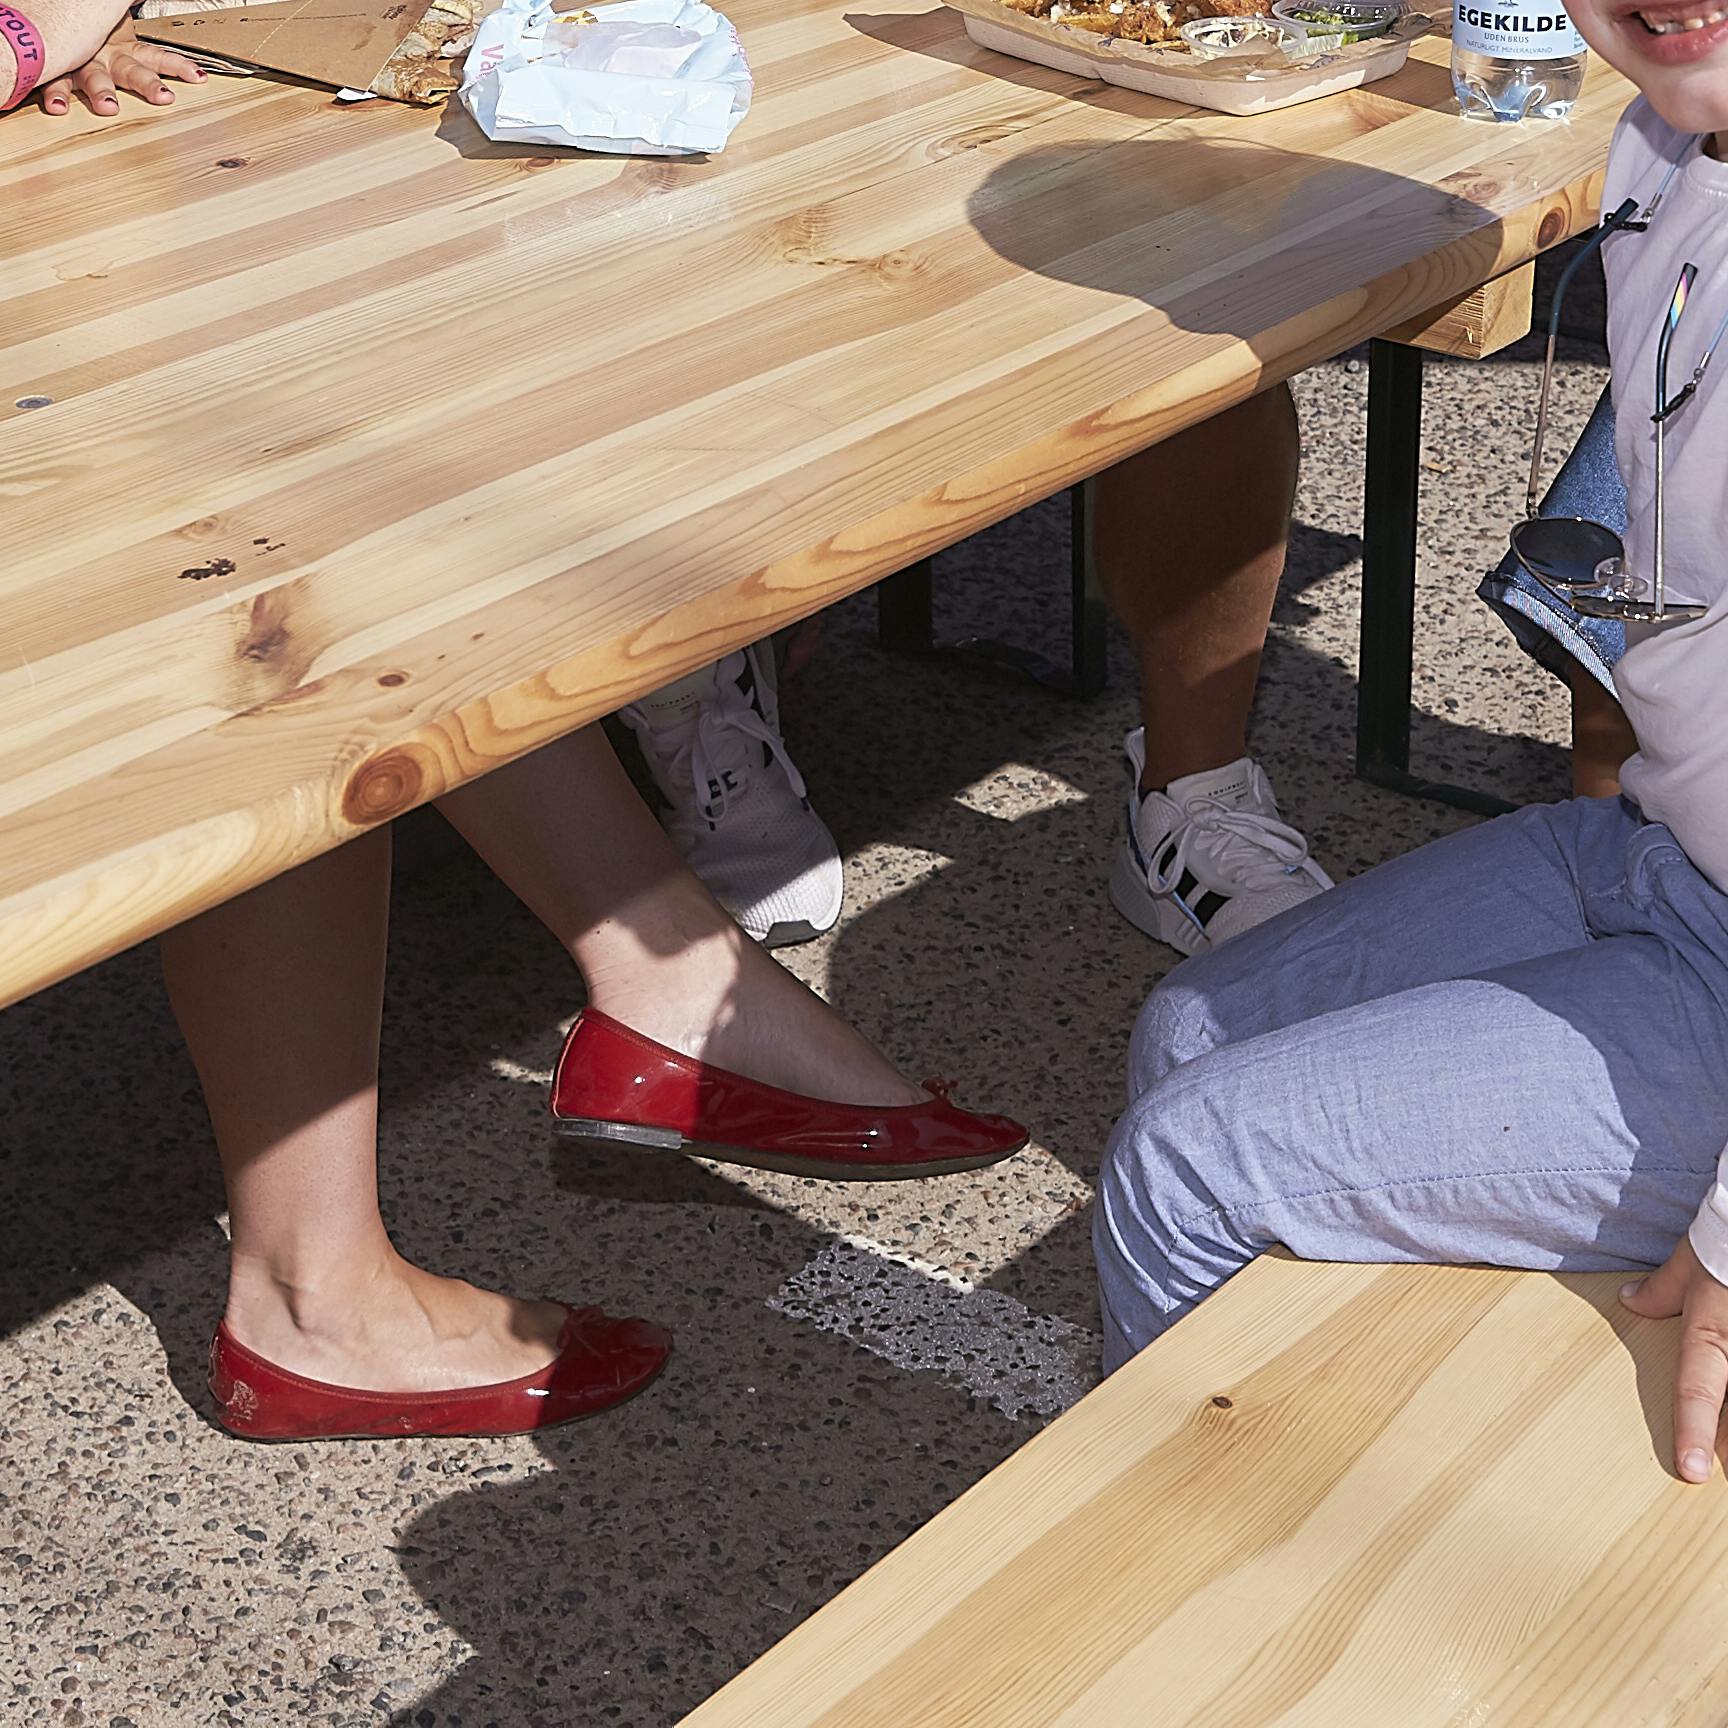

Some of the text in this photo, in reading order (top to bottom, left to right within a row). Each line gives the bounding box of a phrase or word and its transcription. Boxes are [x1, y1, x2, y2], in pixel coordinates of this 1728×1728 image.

[1459, 4, 1567, 32] EGEKILDE
[1484, 33, 1529, 43] UDEN BRUS
[1466, 39, 1500, 52] NATURLIGT
